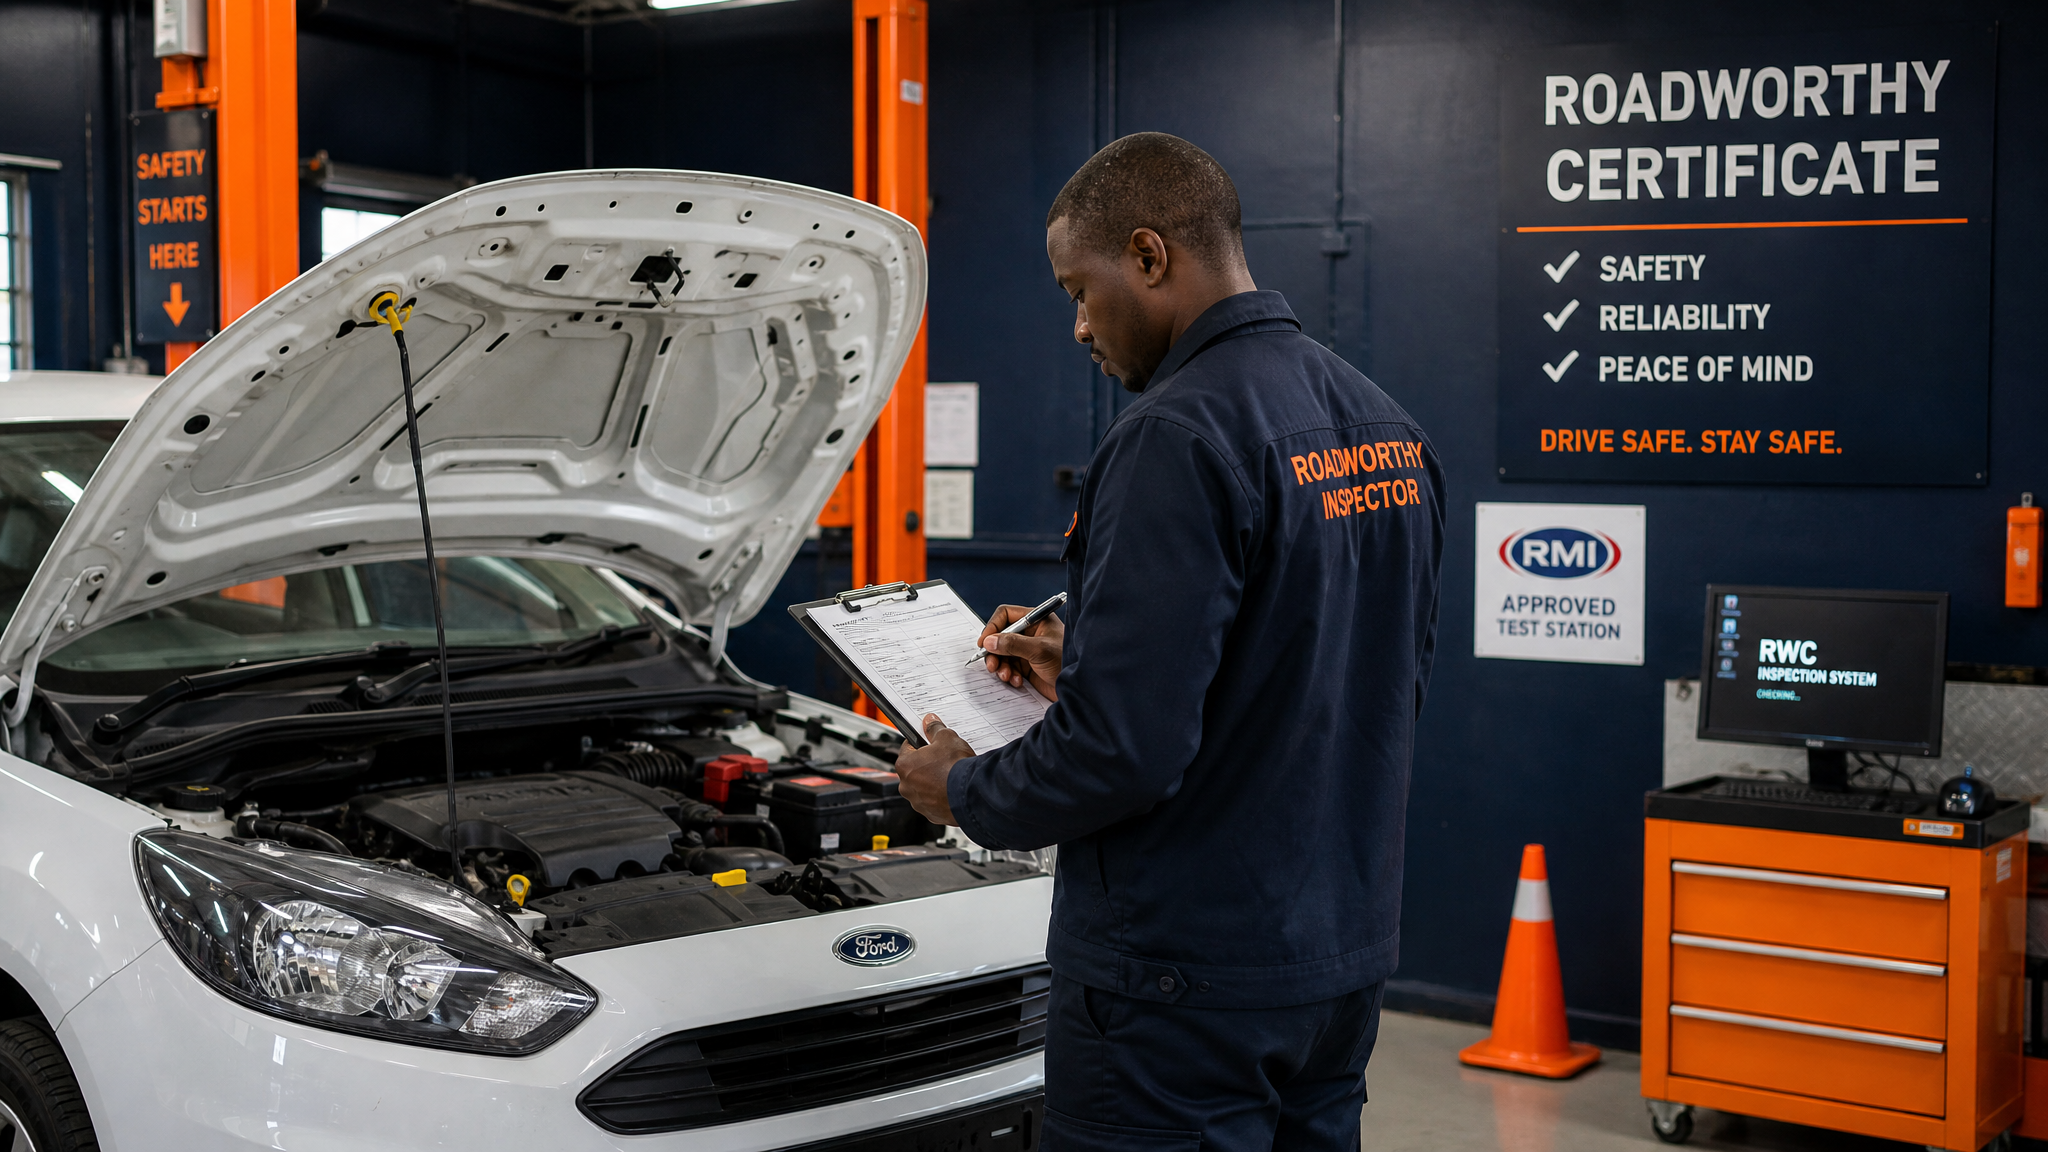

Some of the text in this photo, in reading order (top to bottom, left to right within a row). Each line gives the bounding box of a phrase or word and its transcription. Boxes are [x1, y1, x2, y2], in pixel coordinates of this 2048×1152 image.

[1545, 59, 1951, 126] ROADWORTHY
[137, 149, 206, 180] SAFETY
[1546, 138, 1940, 203] CERTIFICATE
[138, 195, 207, 225] STARTS
[149, 241, 199, 270] HERE
[1599, 254, 1706, 282] SAFETY
[1599, 303, 1771, 331] RELIABILITY
[1598, 355, 1814, 382] PEACE OF MIND
[1540, 429, 1843, 455] DRIVE SAFE. STAY SAFE.
[1290, 441, 1424, 486] ROADWORTHY
[1321, 478, 1421, 520] INSPECTOR
[1522, 539, 1597, 568] RMI
[1502, 595, 1616, 617] APPROVED
[1497, 618, 1621, 640] TEST STATION
[1759, 638, 1818, 665] RWC
[1757, 666, 1827, 684] INSPECTION
[1829, 669, 1877, 687] SYSTEM
[855, 934, 899, 958] Ford
